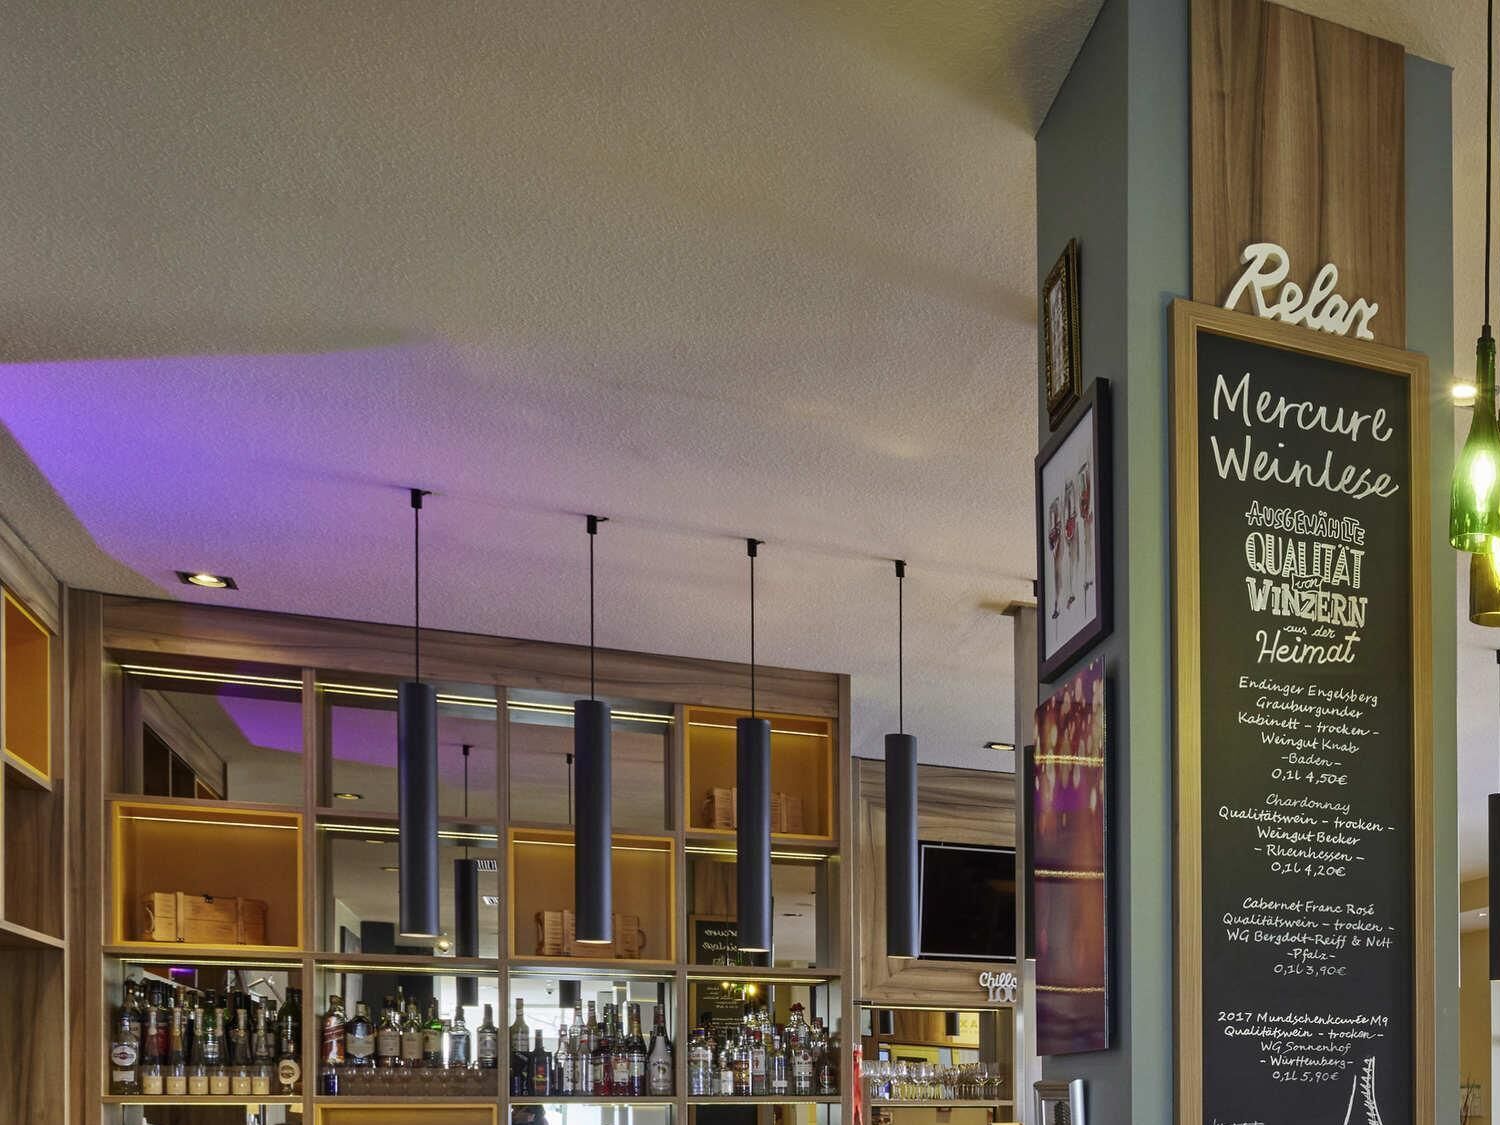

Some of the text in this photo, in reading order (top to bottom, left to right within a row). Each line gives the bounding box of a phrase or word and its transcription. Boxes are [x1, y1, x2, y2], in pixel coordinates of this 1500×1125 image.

[1223, 243, 1378, 340] Relax
[1213, 373, 1392, 441] Mercure
[1211, 435, 1399, 499] Weinlese
[1245, 500, 1365, 545] AUSGEWÄHLTE
[1246, 532, 1365, 588] QUALITÄT
[1295, 579, 1320, 588] von
[1246, 577, 1368, 628] WINZERN
[1284, 625, 1335, 638] aus der
[1256, 630, 1360, 663] Heimat
[1240, 676, 1377, 707] Endinger Engelsberg
[1257, 697, 1363, 718] Grauburgunder
[1239, 712, 1300, 730] Kabinett
[1317, 722, 1369, 736] trocken
[1262, 732, 1359, 754] Weingut Knab
[1306, 772, 1347, 785] 4,50€
[1266, 794, 1350, 814] Chardonnay
[1219, 806, 1317, 825] Qualitätswein
[1334, 817, 1384, 832] trocken
[1257, 826, 1360, 846] Weingut Becker
[1267, 845, 1353, 861] Rheinhessen
[1305, 865, 1346, 876] 4,20€
[1243, 897, 1374, 915] Cabernet Franc Rosé
[1223, 913, 1318, 929] Qualitätswein
[1334, 920, 1383, 932] trocken
[1227, 929, 1249, 943] WG
[1352, 937, 1360, 946] &
[1366, 937, 1392, 948] Nett
[1306, 966, 1346, 976] 3,90€
[1218, 1012, 1252, 1022] 2017
[1225, 1026, 1313, 1037] Qualitätswein
[1329, 1029, 1376, 1039] trocken
[1261, 1041, 1351, 1055] WG Sonnenhof
[1301, 1072, 1339, 1082] 5,90€
